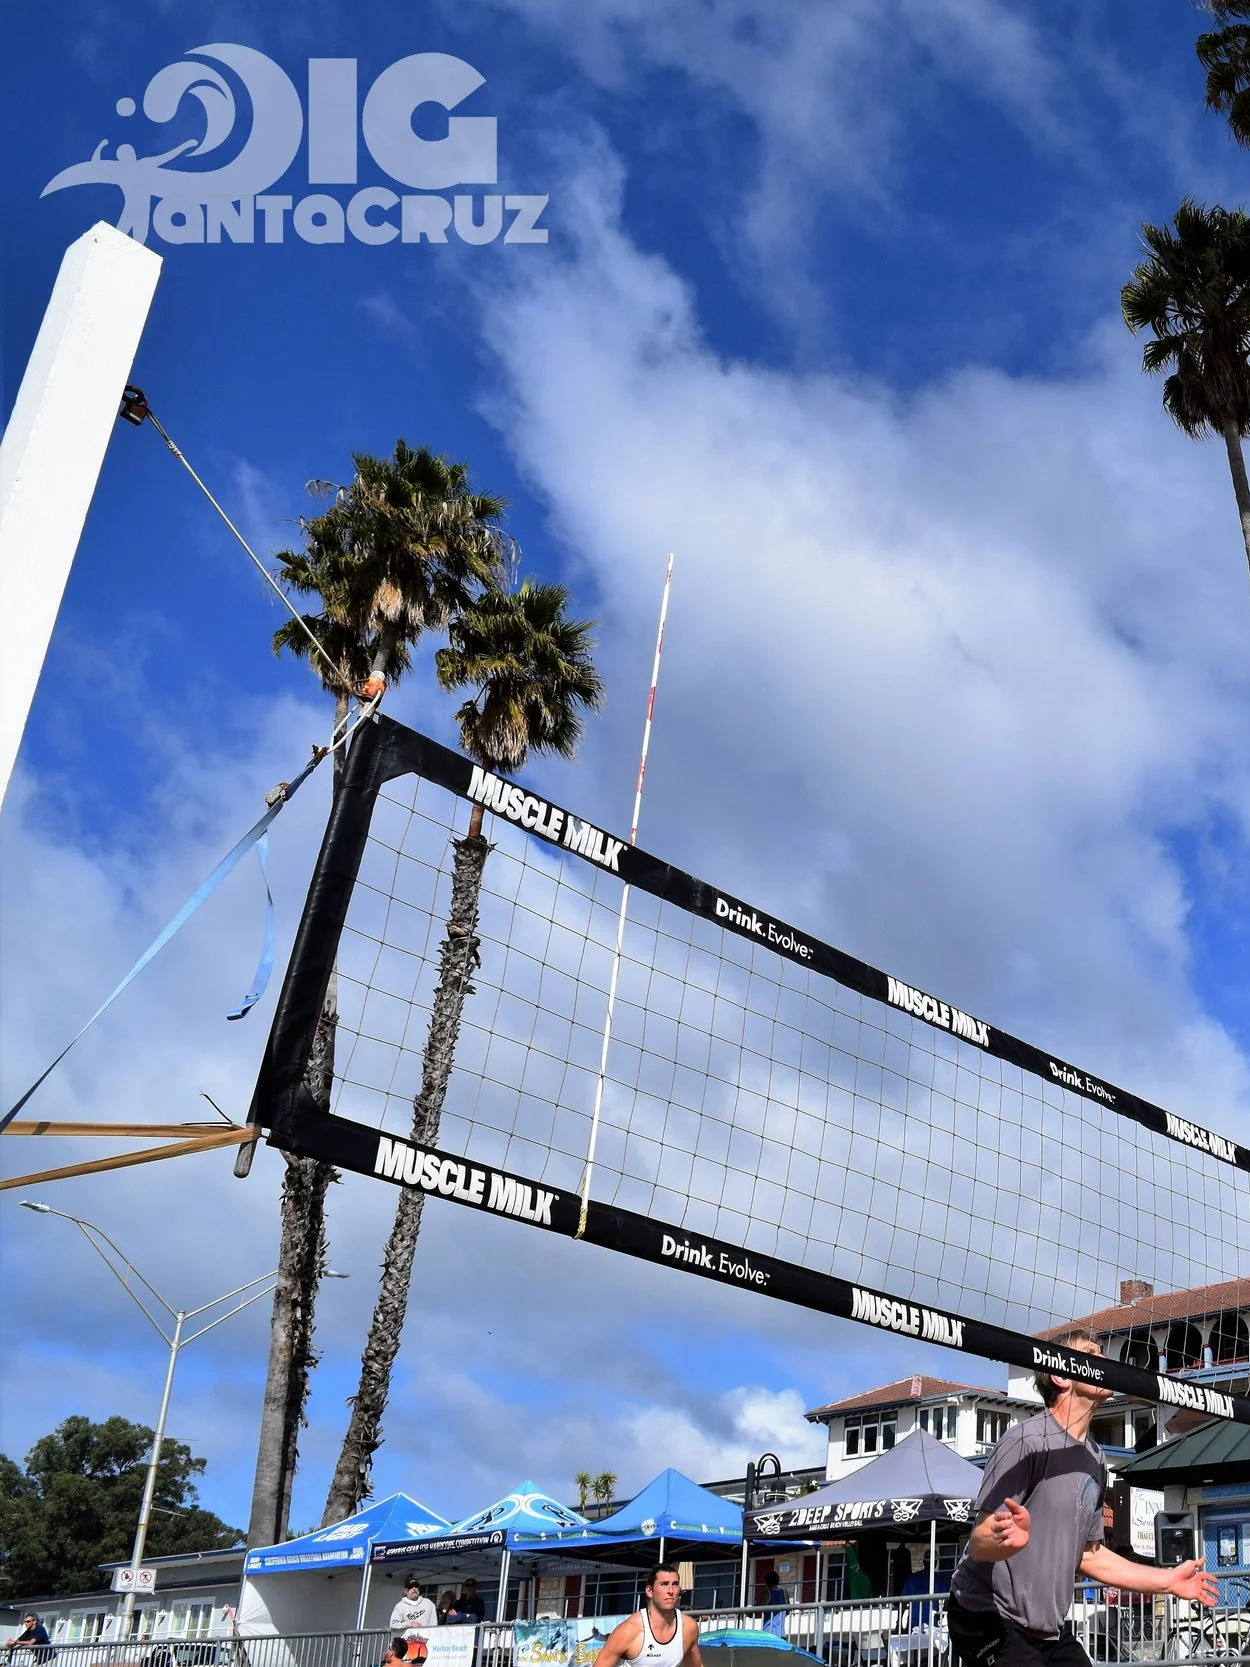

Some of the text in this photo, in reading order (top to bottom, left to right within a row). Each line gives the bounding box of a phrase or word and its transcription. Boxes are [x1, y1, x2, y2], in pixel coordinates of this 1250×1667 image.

[467, 765, 624, 872] MUSCLE MILK
[716, 898, 766, 937] Drink.
[887, 976, 989, 1047] MUSCLE MILK
[1049, 1061, 1084, 1090] Drink.
[1165, 1112, 1237, 1163] MUSCLE MILK
[374, 1136, 555, 1225] MUSCLE MILK
[661, 1234, 716, 1270] Drink.
[851, 1287, 963, 1347] MUSCLE MILK
[1033, 1346, 1070, 1372] Drink.
[1156, 1375, 1234, 1418] MUSCLE MILK
[788, 1500, 886, 1526] 2DEEP SPORTS
[455, 1537, 490, 1548] COMPETITION
[452, 1644, 467, 1652] Beach
